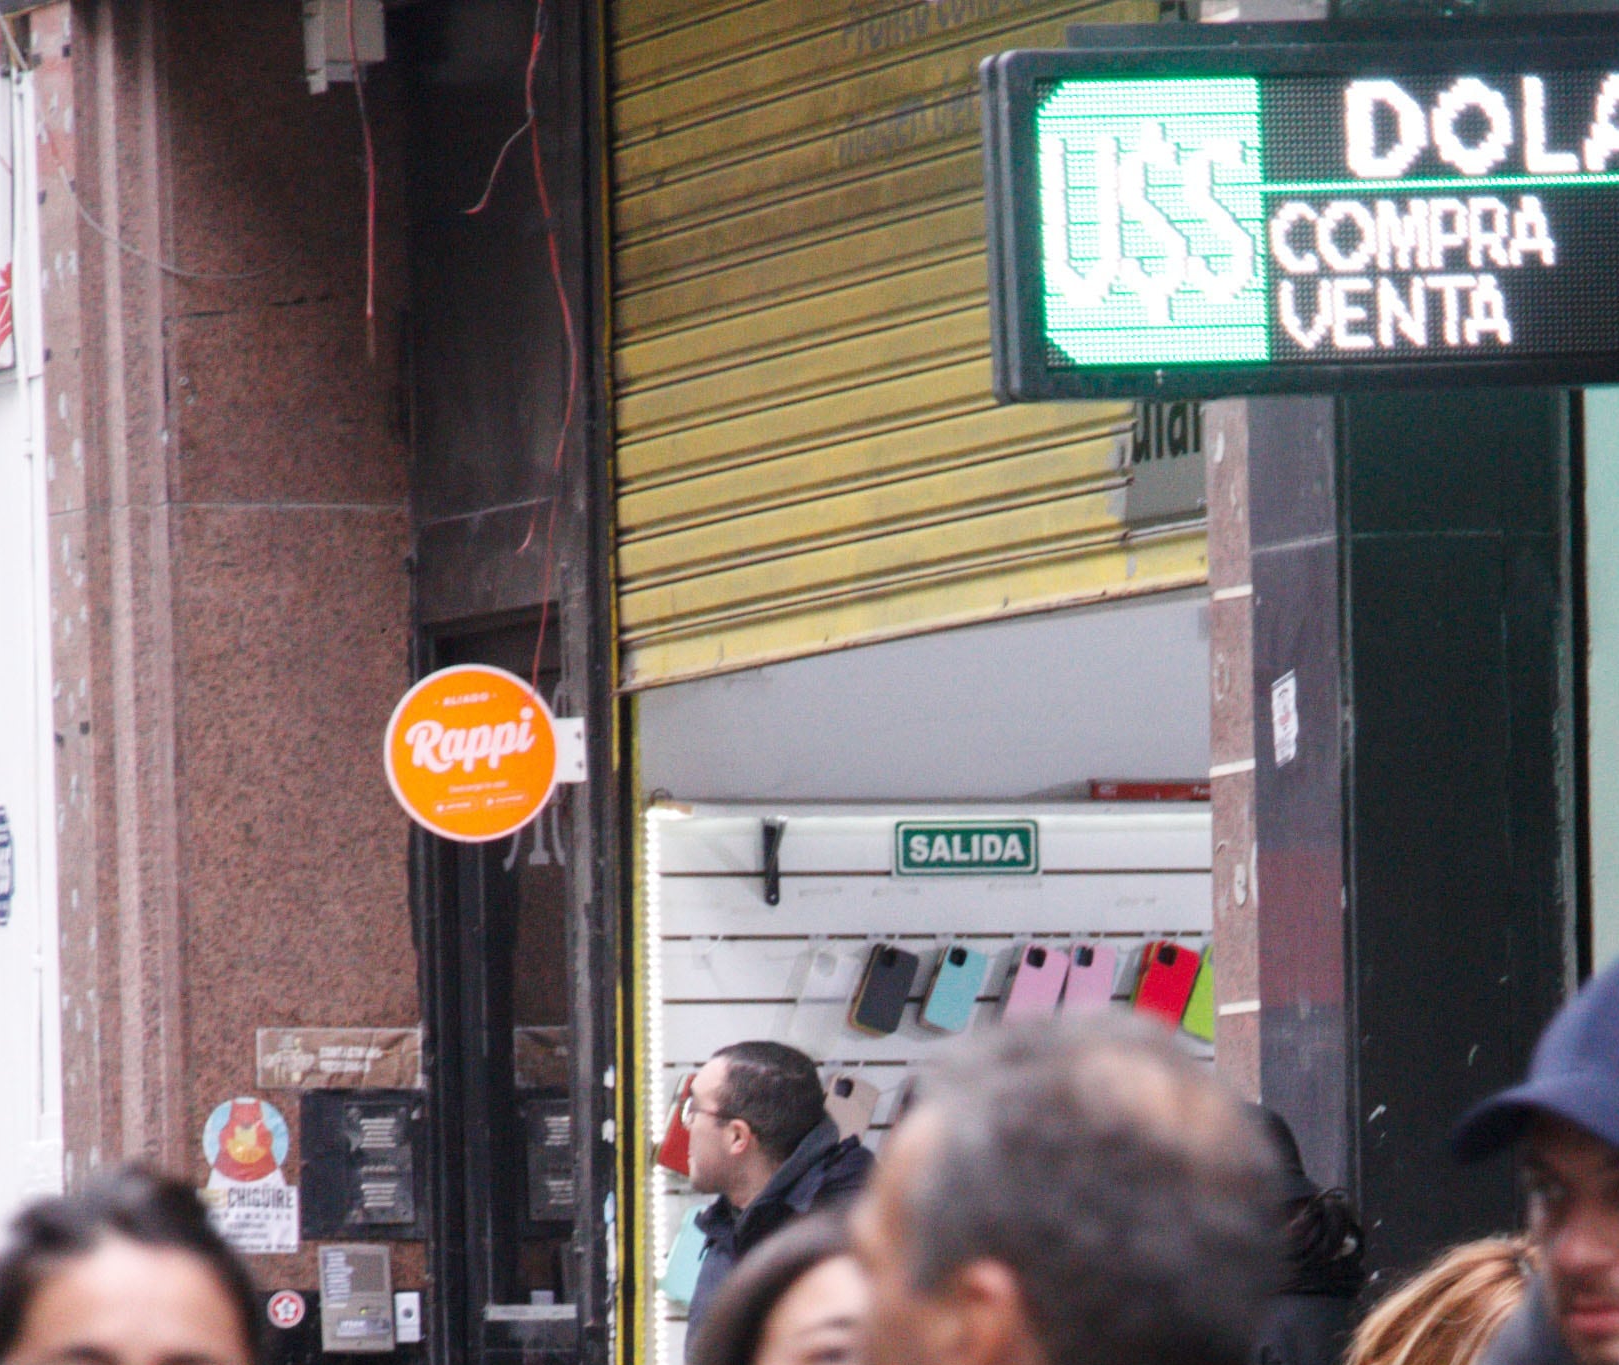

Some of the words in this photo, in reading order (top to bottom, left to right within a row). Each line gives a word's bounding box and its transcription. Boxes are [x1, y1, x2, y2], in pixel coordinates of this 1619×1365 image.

[1270, 195, 1556, 272] COMPRA
[1278, 273, 1511, 349] VENTA
[405, 706, 536, 773] Rappi
[909, 833, 1025, 862] SALIDA
